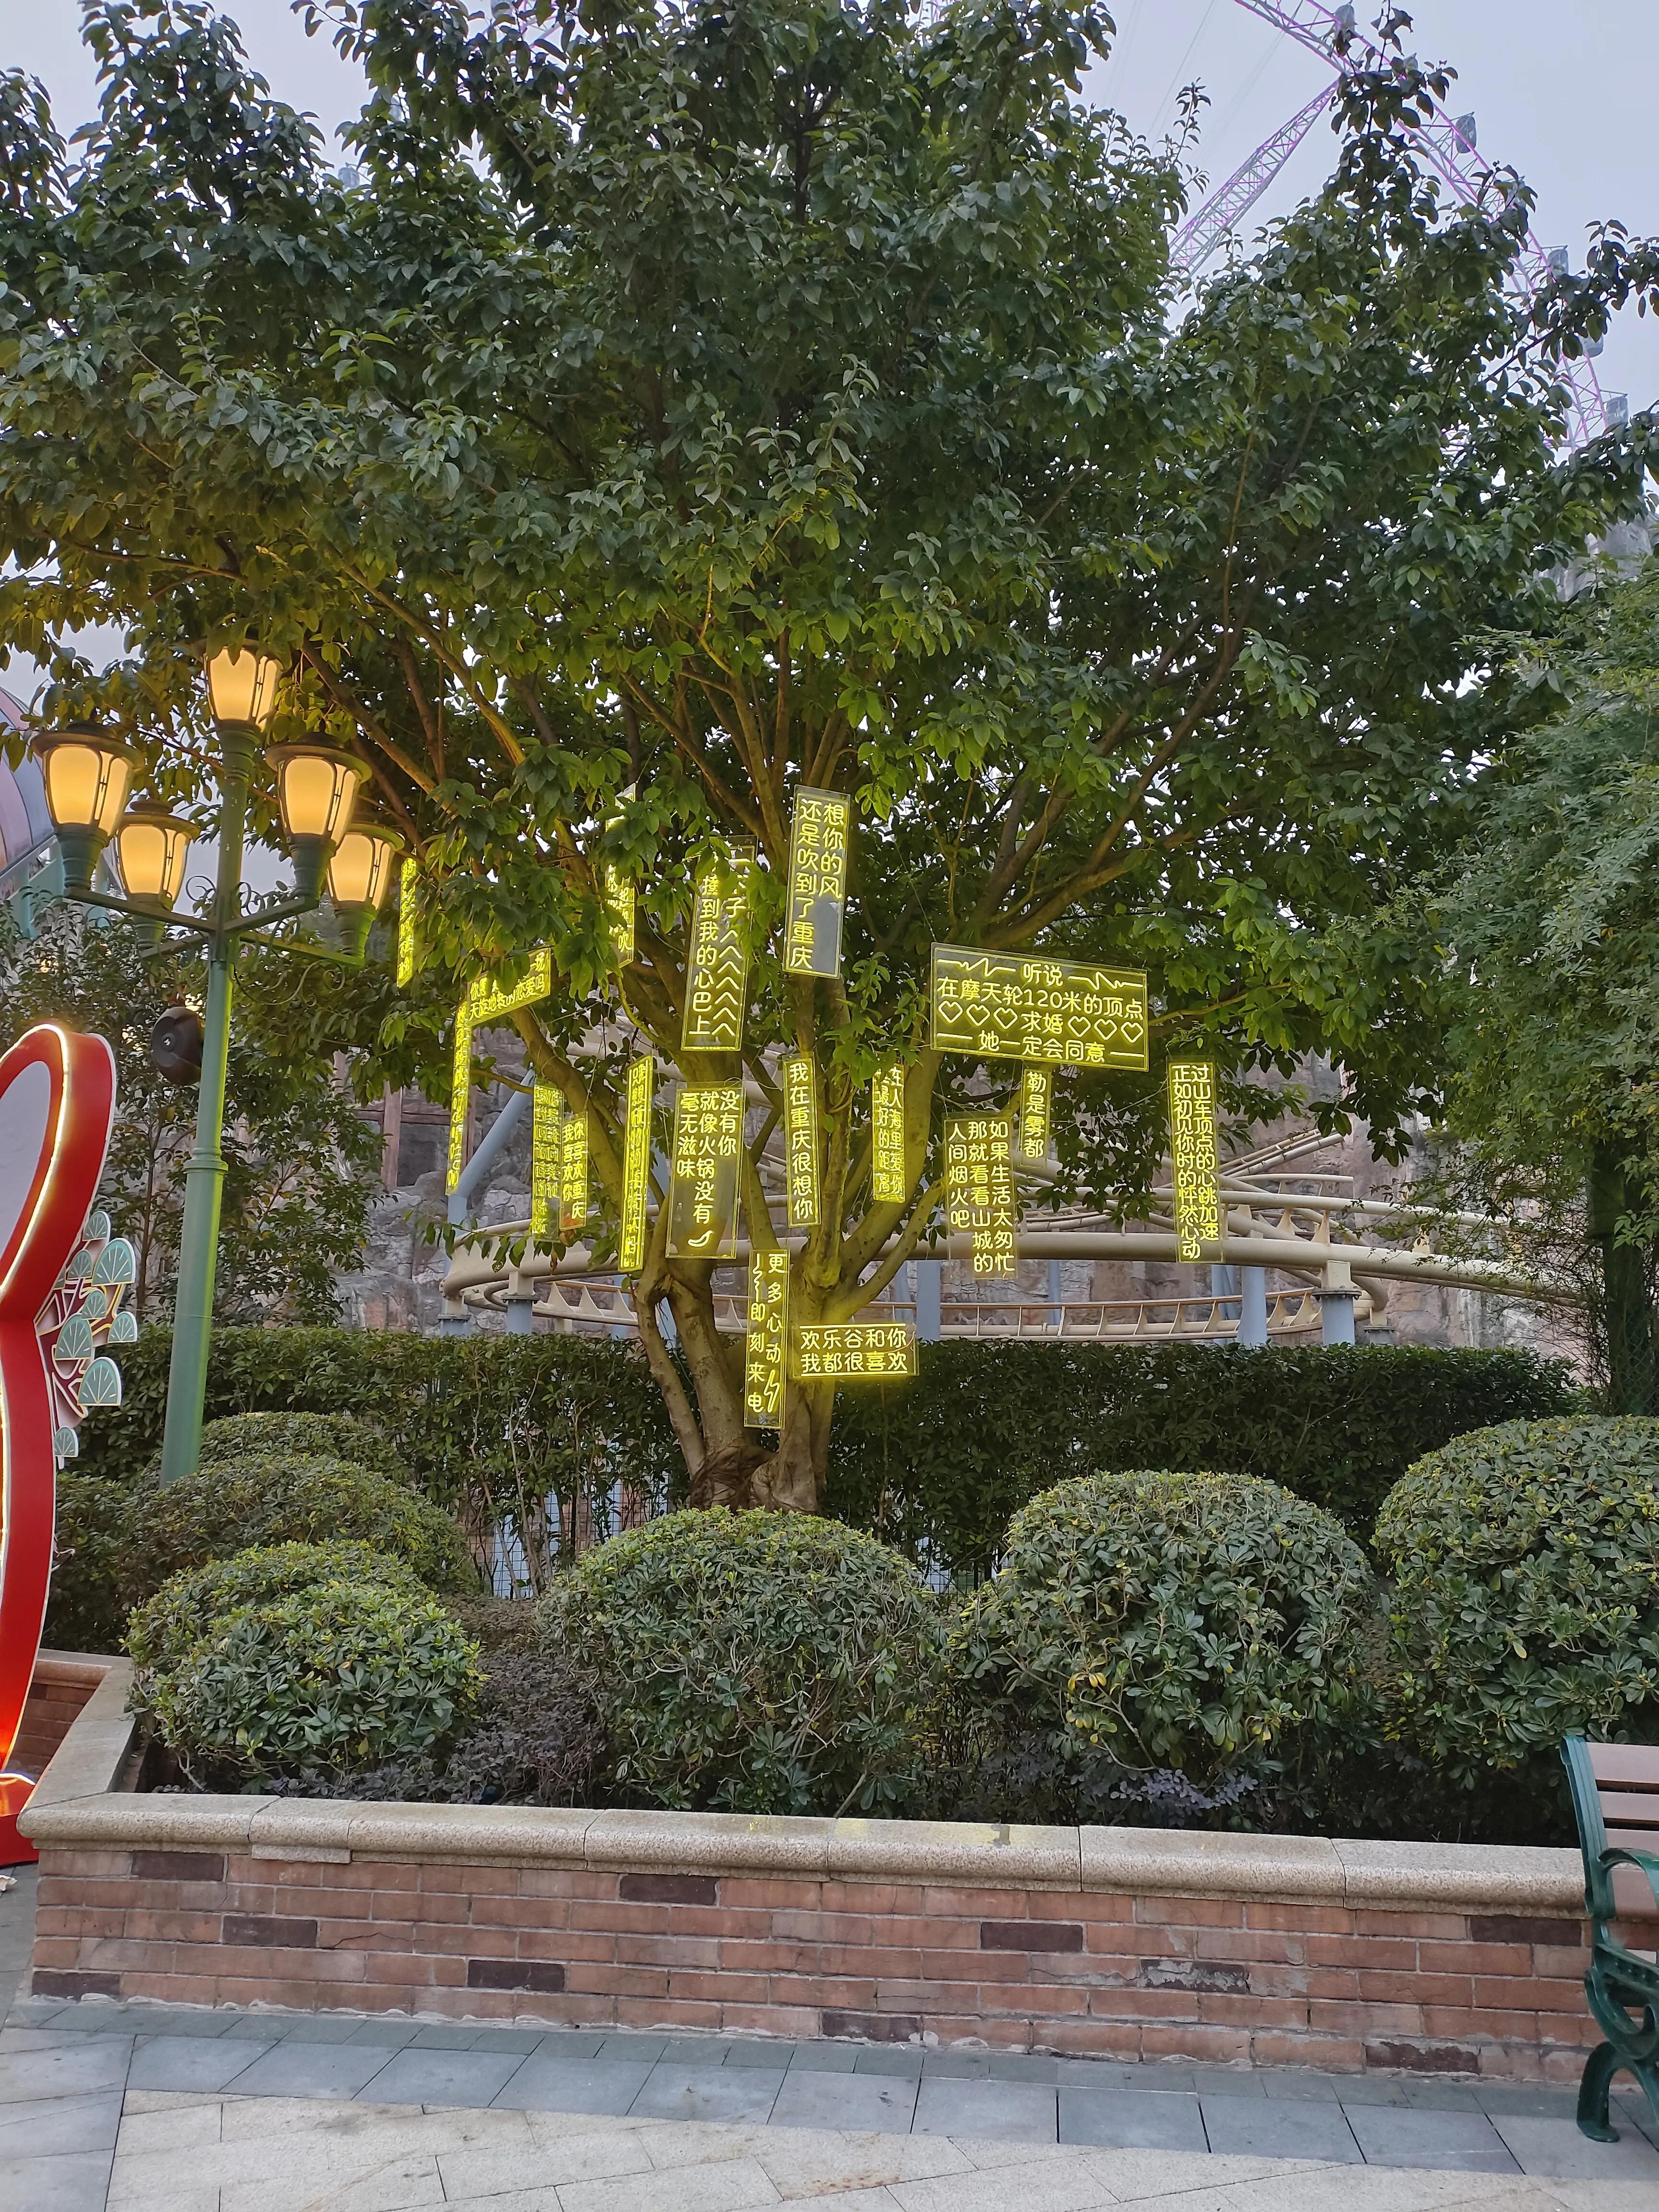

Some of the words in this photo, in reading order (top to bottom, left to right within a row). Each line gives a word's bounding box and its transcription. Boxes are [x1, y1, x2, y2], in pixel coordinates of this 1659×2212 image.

[790, 798, 822, 969] 还是吹到了重庆
[818, 802, 845, 899] 想你的风
[688, 851, 721, 1036] 撞到我的心巴上
[1023, 963, 1063, 987] 听说
[937, 976, 1143, 1021] 在摩天轮120米的顶点
[978, 1030, 1106, 1063] 她一定会同意
[1021, 1012, 1064, 1034] 求婚
[562, 1124, 574, 1202] 我喜欢你
[677, 1092, 699, 1179] 毫无滋味
[693, 1091, 720, 1225] 就像火锅没有
[718, 1091, 741, 1156] 没有你
[789, 1062, 814, 1220] 我在重庆很想你
[1023, 1071, 1046, 1158] 勒是雾都
[1172, 1065, 1201, 1260] 正如初见你时的怦然心动
[1190, 1064, 1220, 1241] 过山车顶点的心跳加速
[572, 1120, 585, 1219] 你喜欢重庆
[948, 1122, 971, 1229] 人间烟火吧
[968, 1120, 994, 1273] 那就看看山城的
[988, 1120, 1016, 1273] 如果生活太匆忙
[747, 1302, 766, 1413] 即刻来电
[765, 1253, 787, 1364] 更多心动
[800, 1327, 907, 1350] 欢乐谷和你
[800, 1351, 908, 1373] 我都很喜欢
